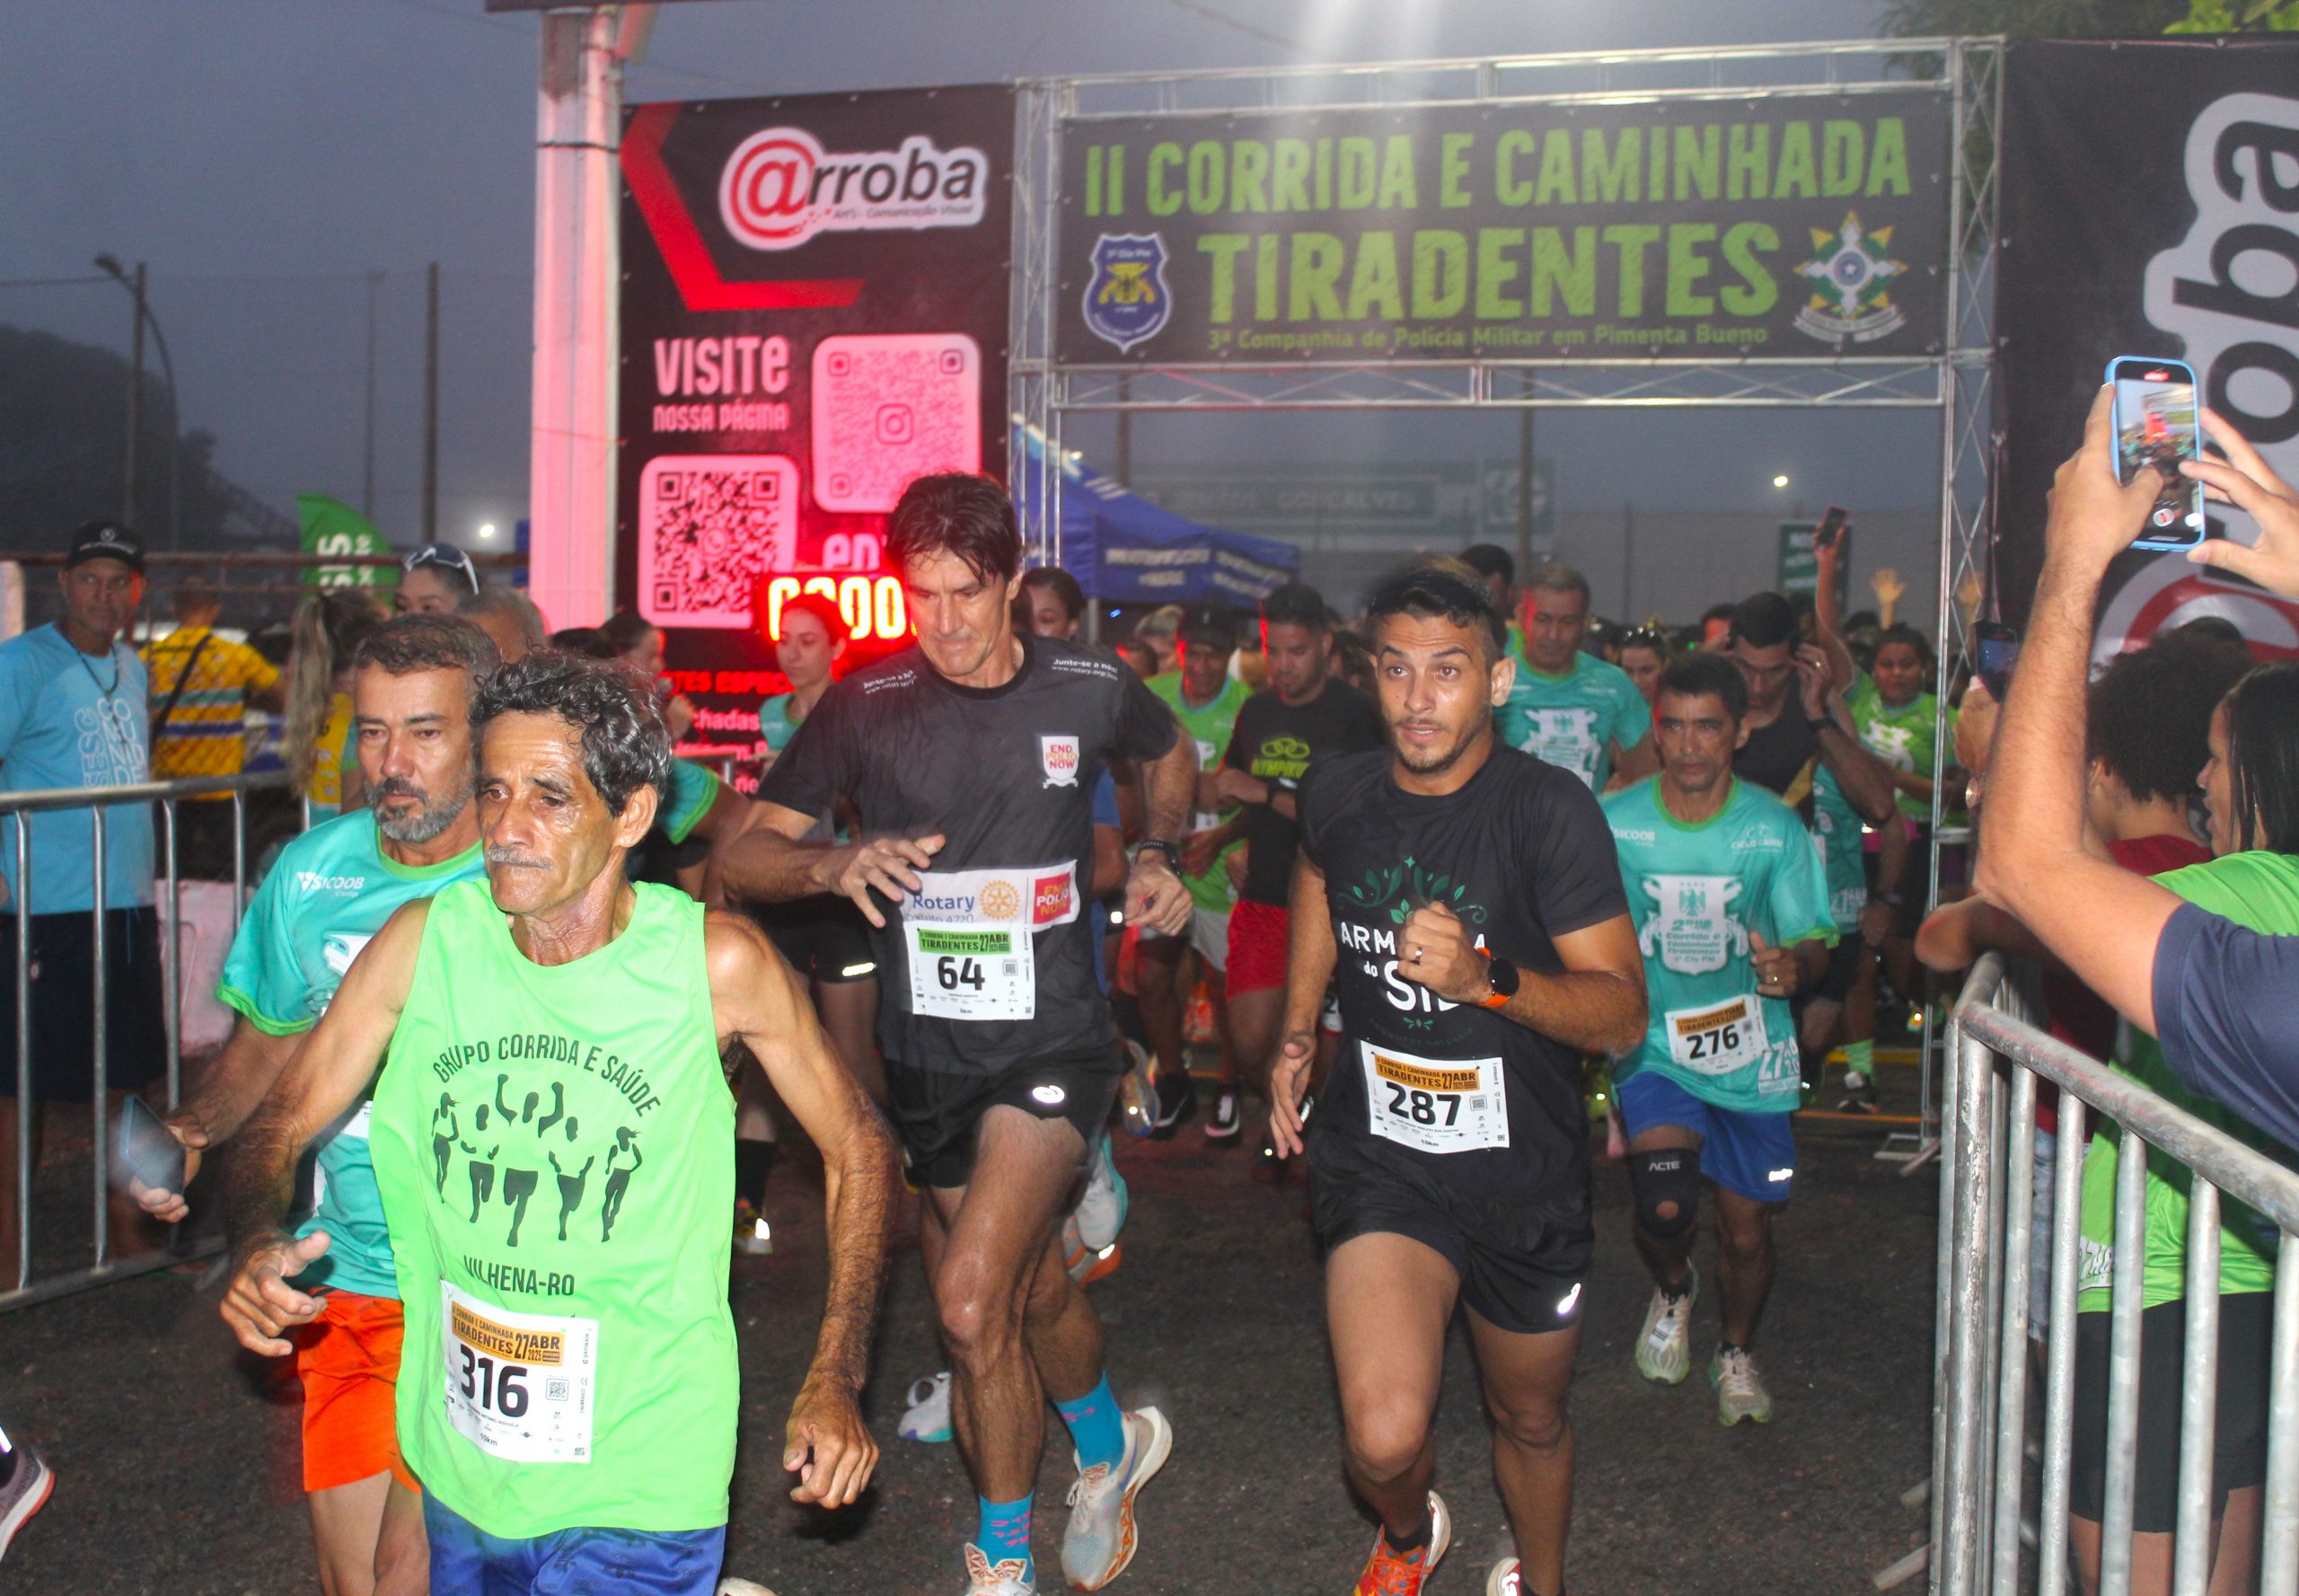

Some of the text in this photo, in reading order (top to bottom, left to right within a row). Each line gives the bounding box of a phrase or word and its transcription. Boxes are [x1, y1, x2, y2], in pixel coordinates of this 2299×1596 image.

[1085, 117, 1911, 216] II CORRIDA E CAMINHADA
[1196, 221, 1780, 324] TIRADENTES
[1209, 323, 1768, 352] 3ª Companhia de Polícia Militar em Pimenta Bueno
[1045, 753, 1078, 762] POLIO
[1050, 745, 1073, 754] END
[1049, 760, 1075, 769] NOW
[1615, 828, 1656, 842] SICOOB
[312, 874, 365, 890] SICOOB
[912, 895, 974, 913] Rotary
[1035, 888, 1070, 907] POLIO
[920, 938, 980, 951] TIRADENTES
[979, 934, 989, 952] 27
[989, 933, 1009, 943] ABR
[938, 956, 986, 991] 64
[1363, 960, 1379, 977] do
[1687, 1023, 1740, 1060] 276
[433, 1033, 662, 1118] GRUPO CORRIDA E SAÚDE
[1378, 1064, 1441, 1089] TIRADENTES
[1441, 1072, 1452, 1090] 27
[1452, 1072, 1476, 1081] ABR
[1386, 1080, 1462, 1127] 287
[1649, 1160, 1681, 1172] ACTE
[456, 1307, 475, 1325] CORRIDA
[479, 1319, 515, 1340] CAMINHADA
[452, 1317, 514, 1354] TIRADENTES
[514, 1333, 529, 1360] 27
[528, 1335, 561, 1350] ABR
[527, 1350, 542, 1362] 2025
[459, 1343, 530, 1419] 316
[480, 1432, 498, 1447] 10km
